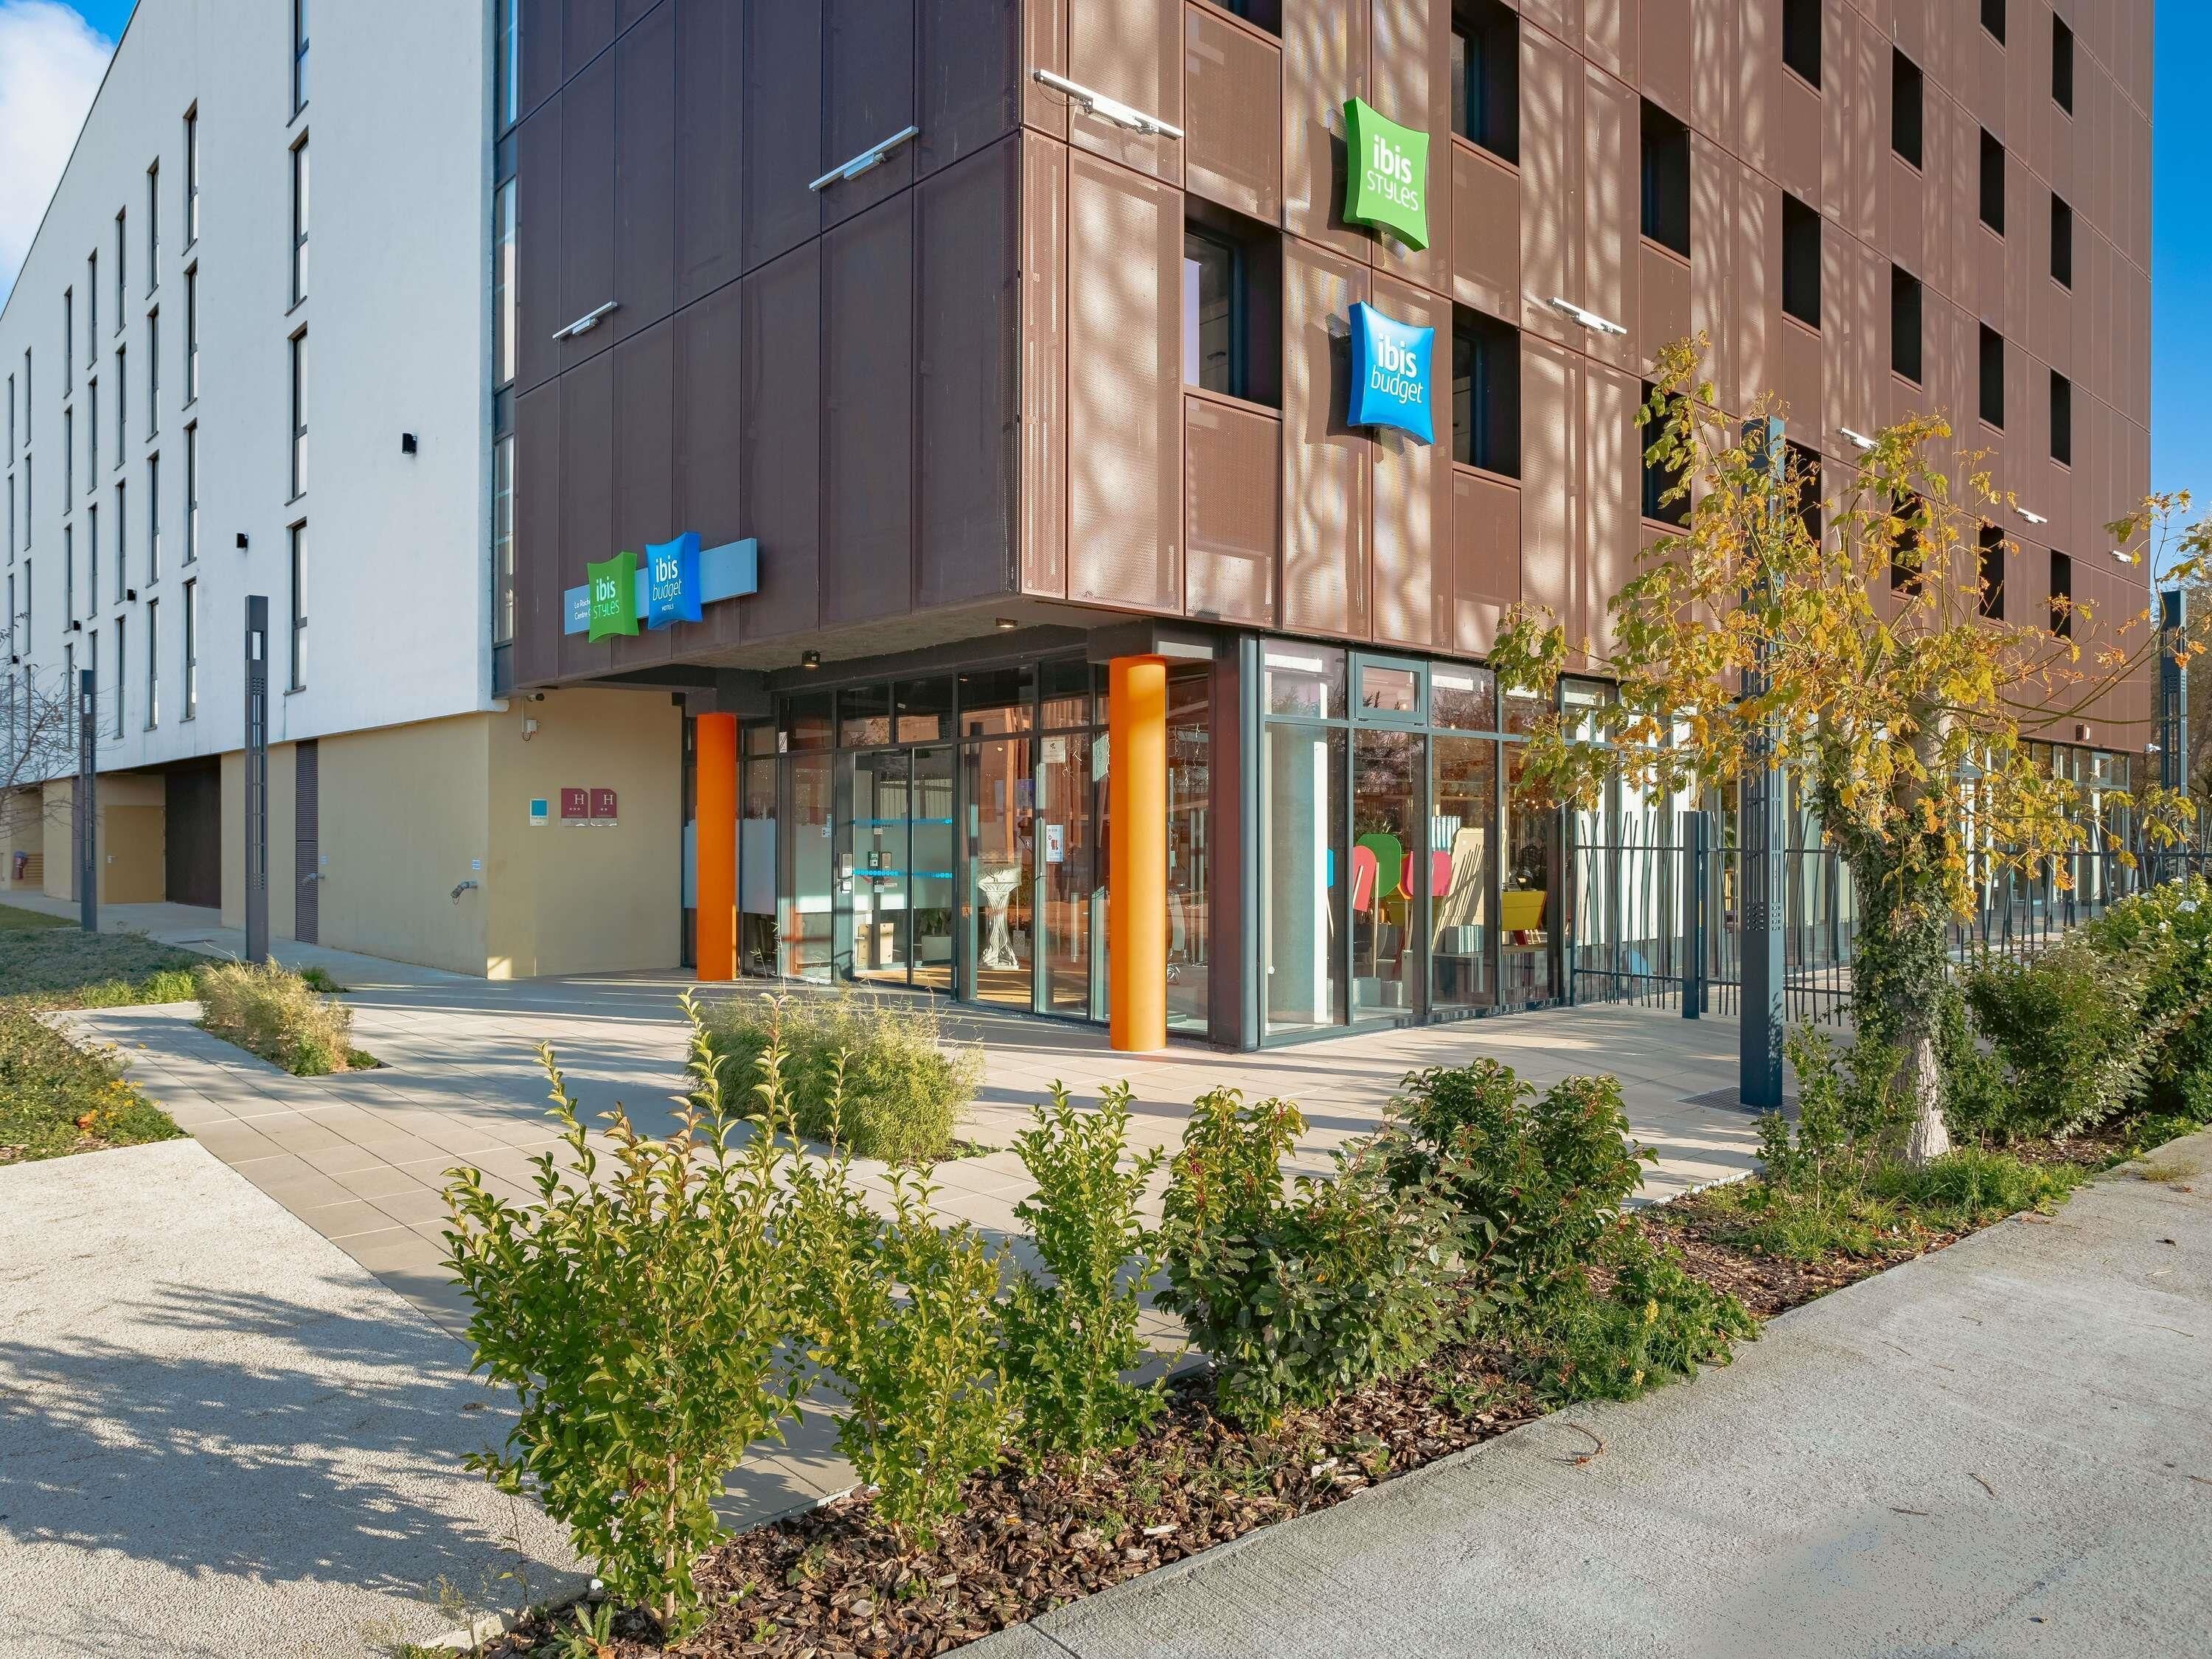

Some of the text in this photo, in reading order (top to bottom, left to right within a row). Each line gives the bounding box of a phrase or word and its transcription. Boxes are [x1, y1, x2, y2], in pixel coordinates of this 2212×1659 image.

[1374, 133, 1412, 184] ibis
[1377, 333, 1416, 378] ibis
[1371, 364, 1424, 404] budget
[655, 554, 678, 582] ibis
[596, 576, 616, 602] ibis
[653, 579, 682, 602] budget
[574, 794, 584, 804] H
[604, 794, 613, 805] H
